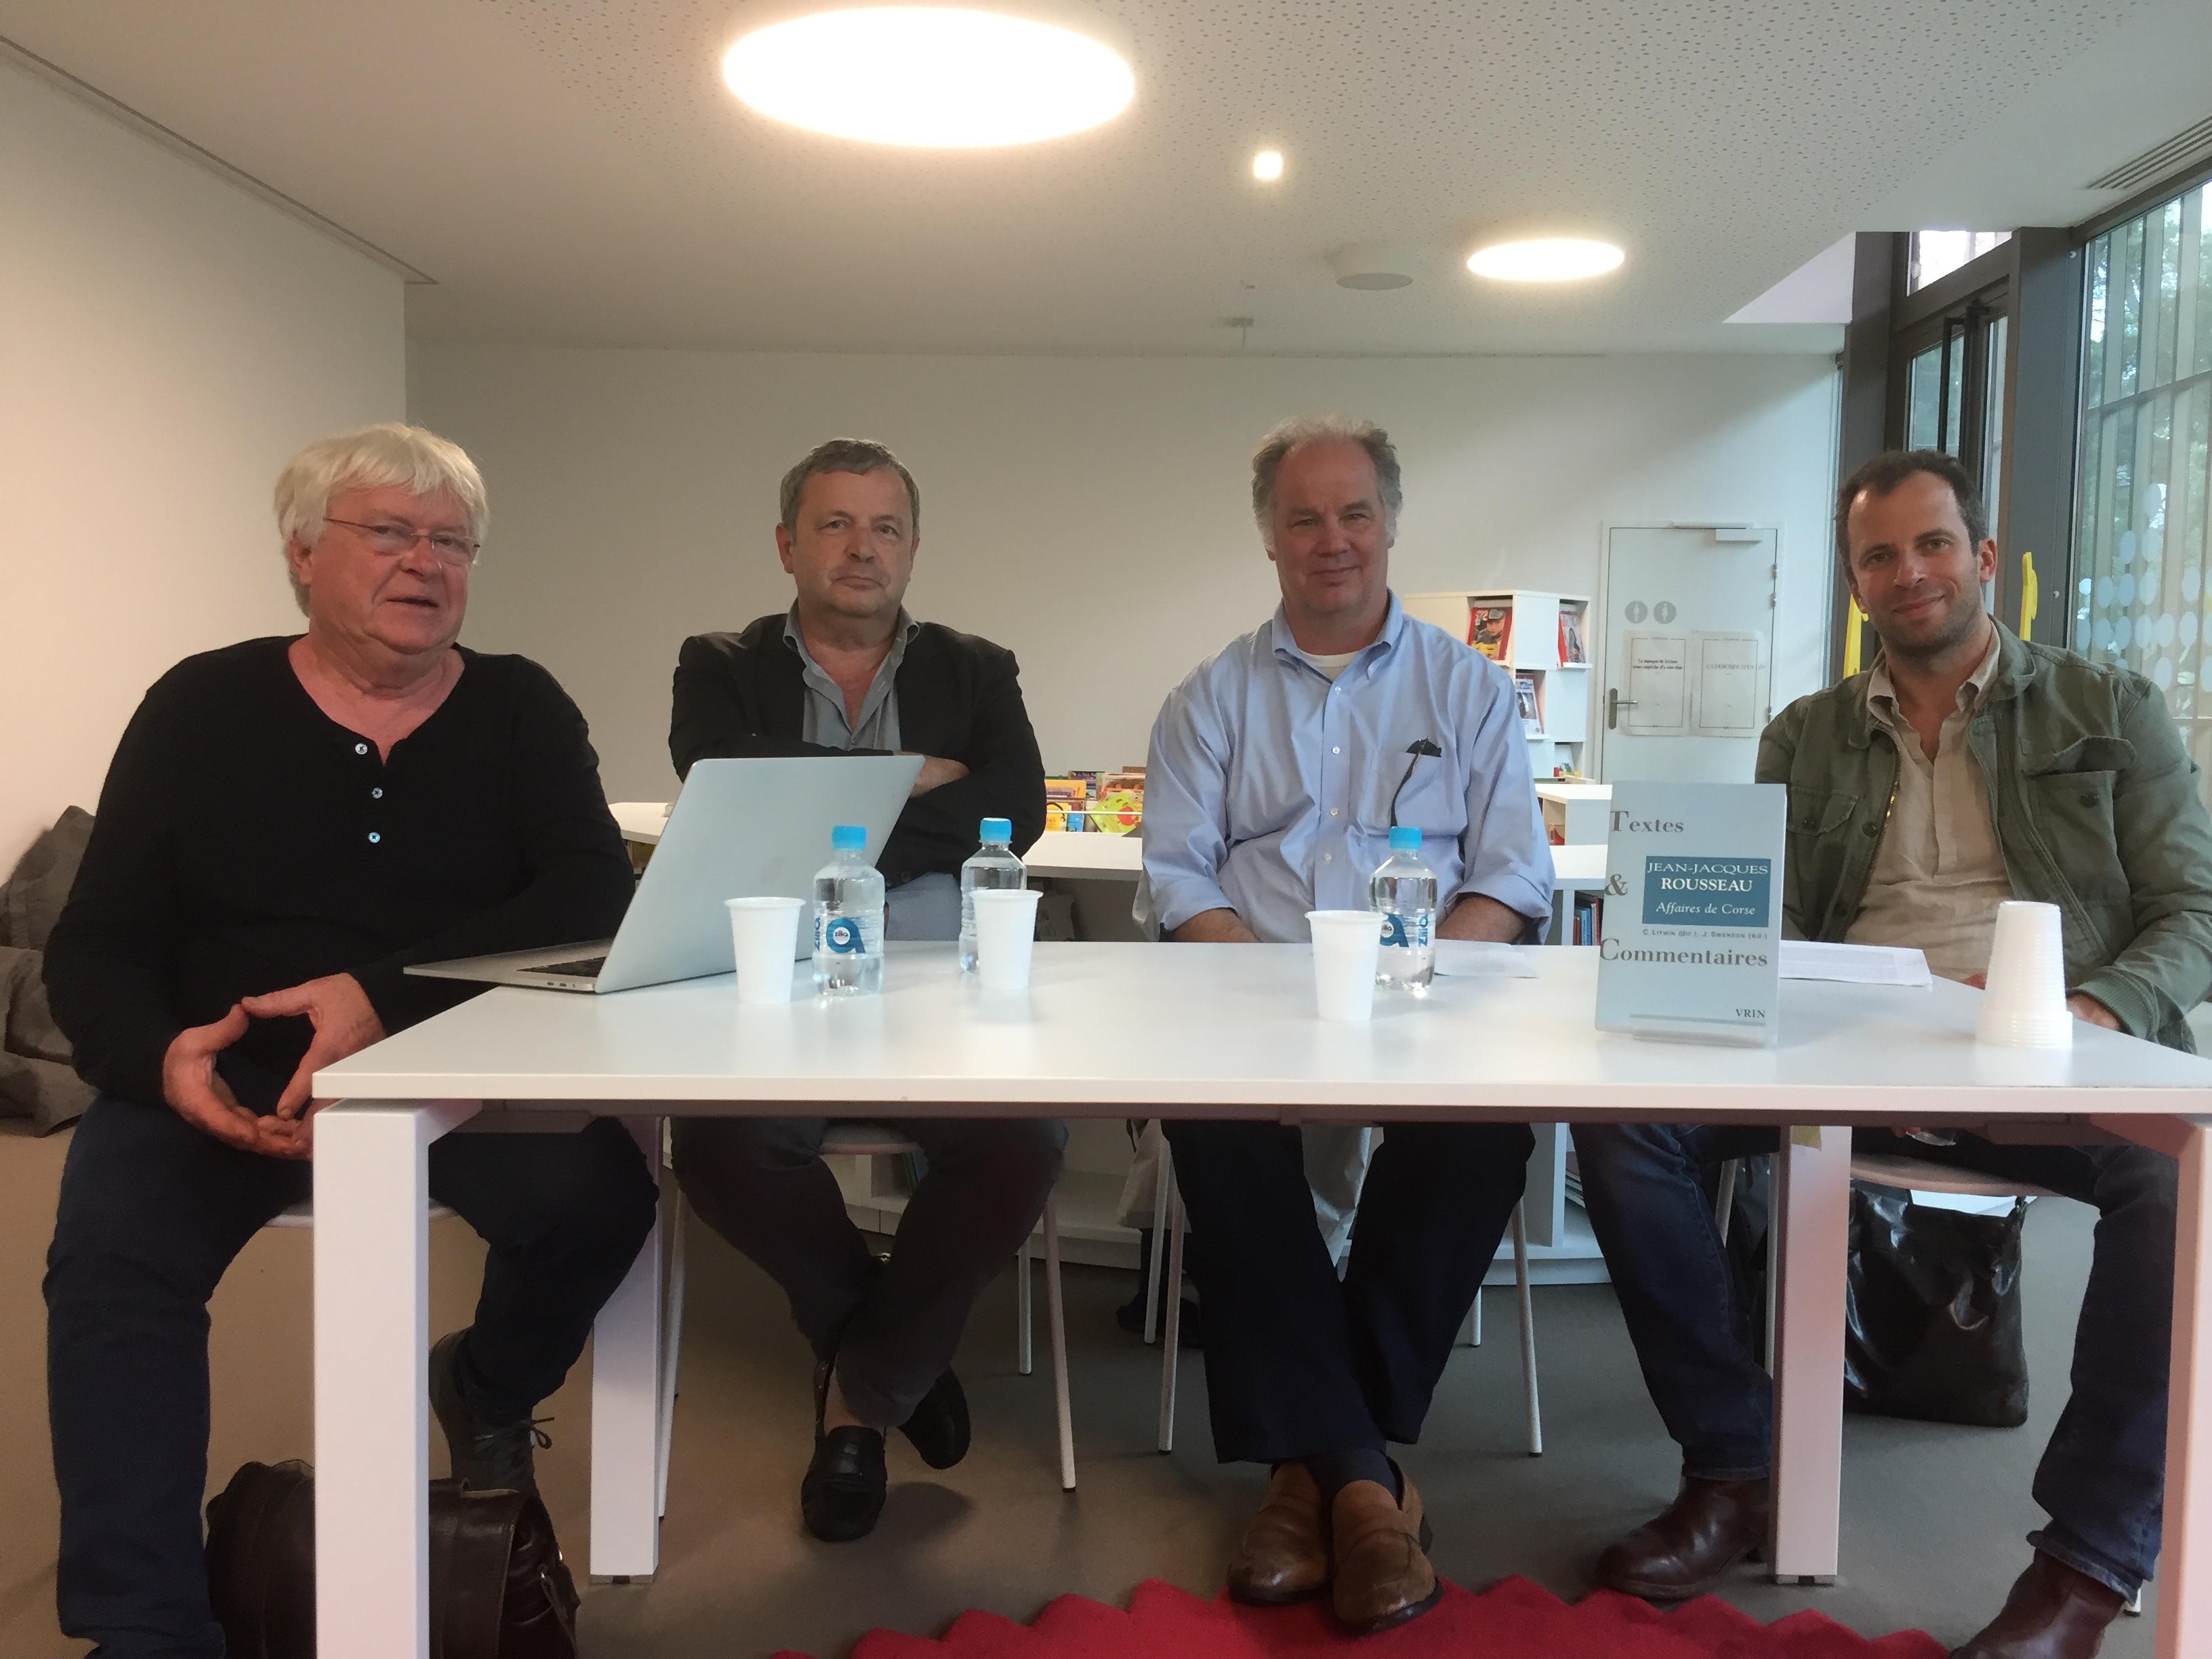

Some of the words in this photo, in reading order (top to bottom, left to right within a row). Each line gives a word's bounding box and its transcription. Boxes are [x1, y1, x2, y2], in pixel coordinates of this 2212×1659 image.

[1610, 811, 1684, 833] Textes
[1647, 862, 1768, 876] JEAN-JACQUES
[1604, 874, 1629, 896] &
[1660, 877, 1753, 892] ROUSSEAU
[1655, 902, 1701, 915] Affaires
[1704, 903, 1718, 914] de
[1721, 903, 1756, 915] Corse
[1599, 938, 1768, 966] Commentaires
[1736, 1008, 1765, 1018] VRIN
